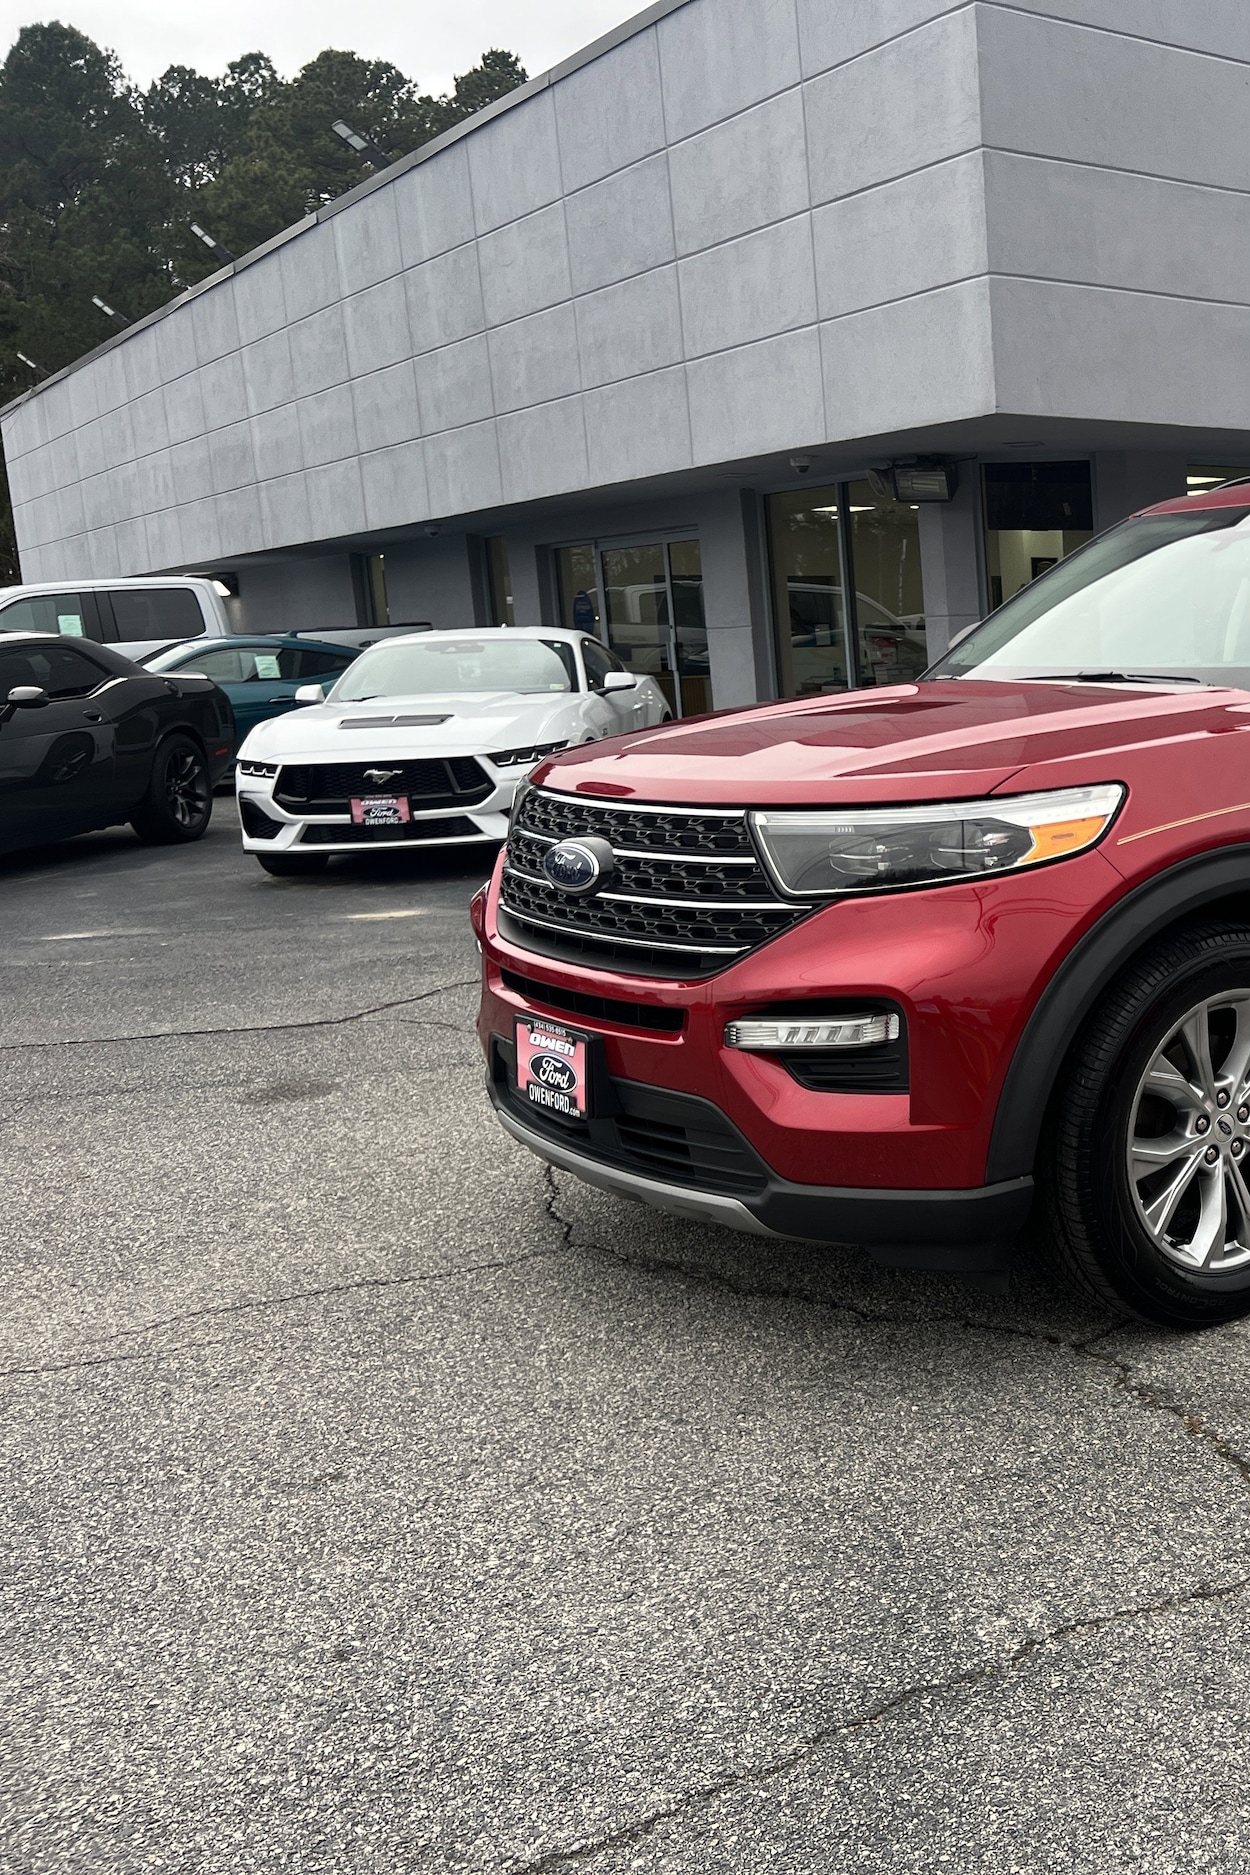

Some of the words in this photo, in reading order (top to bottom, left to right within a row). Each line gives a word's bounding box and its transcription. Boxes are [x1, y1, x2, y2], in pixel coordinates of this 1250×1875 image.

[369, 807, 394, 818] Ford
[552, 851, 582, 880] Ford
[539, 1057, 570, 1089] Ford
